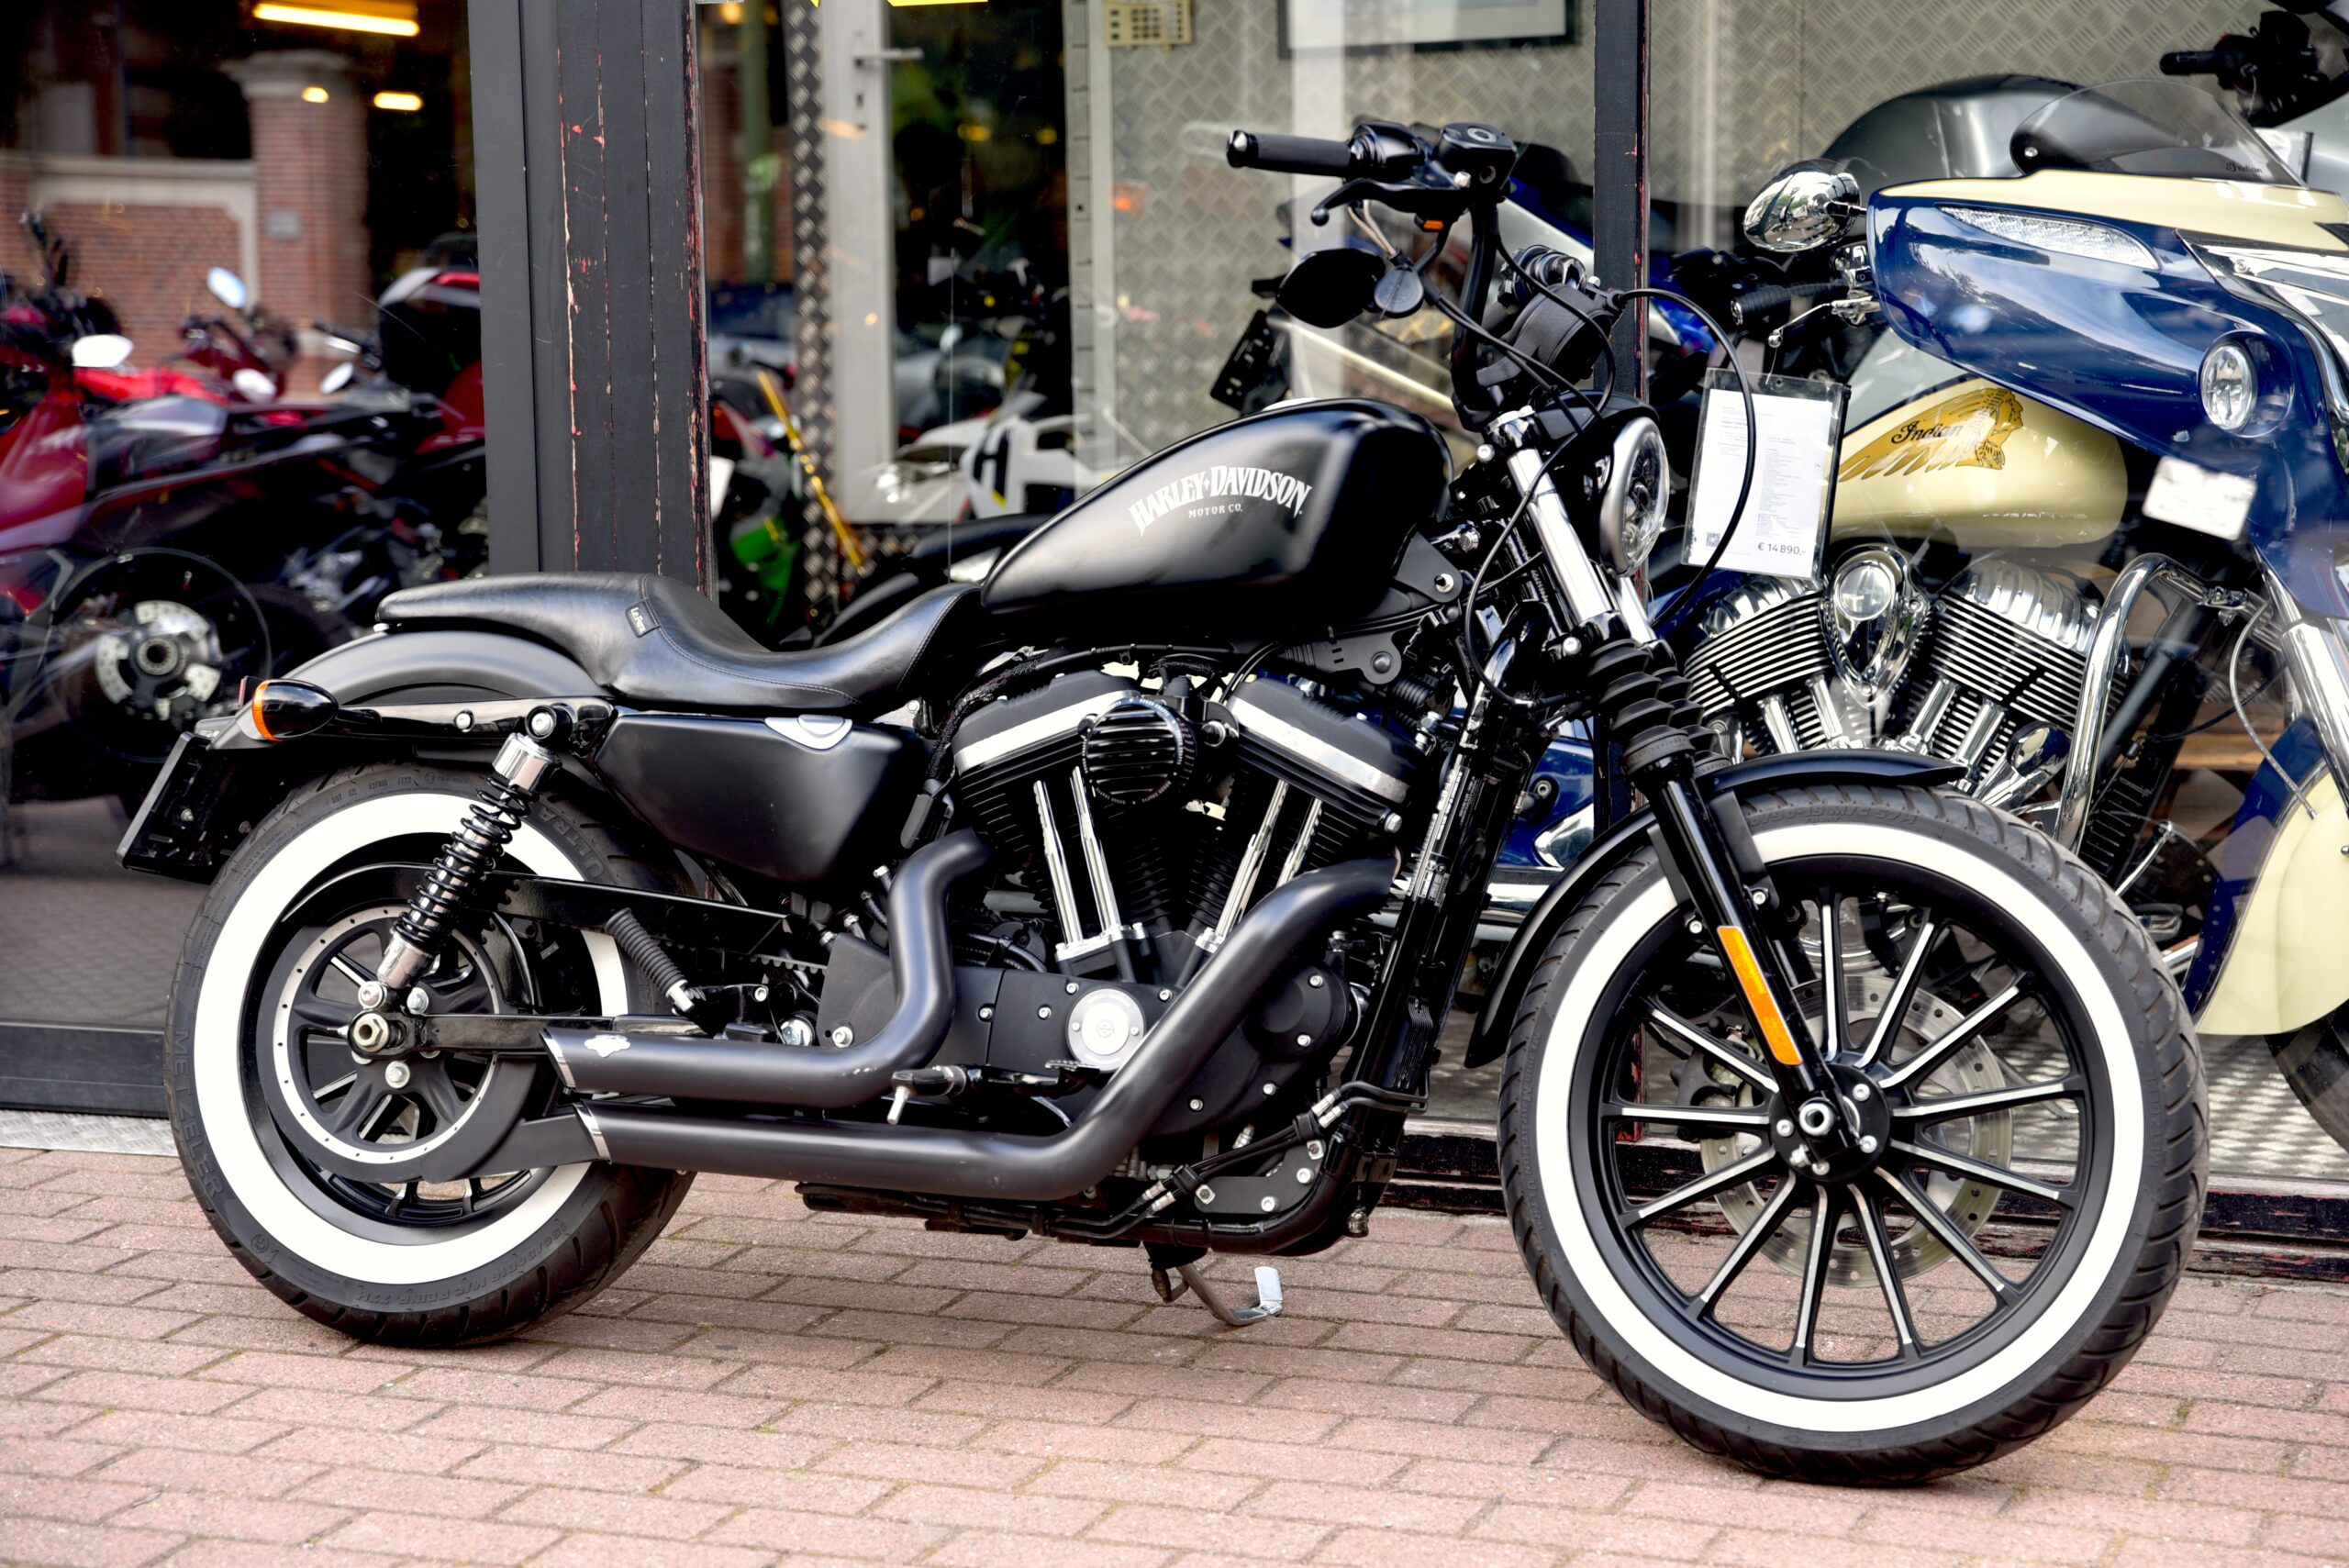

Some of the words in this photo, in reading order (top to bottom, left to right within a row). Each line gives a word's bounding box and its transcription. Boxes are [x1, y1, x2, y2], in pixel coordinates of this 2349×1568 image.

[1891, 420, 1963, 444] Indian
[1188, 506, 1226, 518] MOTOR
[1228, 503, 1243, 513] CO.
[1749, 805, 1826, 826] 0/90-19
[539, 806, 604, 879] ULTRA
[174, 1029, 224, 1198] METZELER
